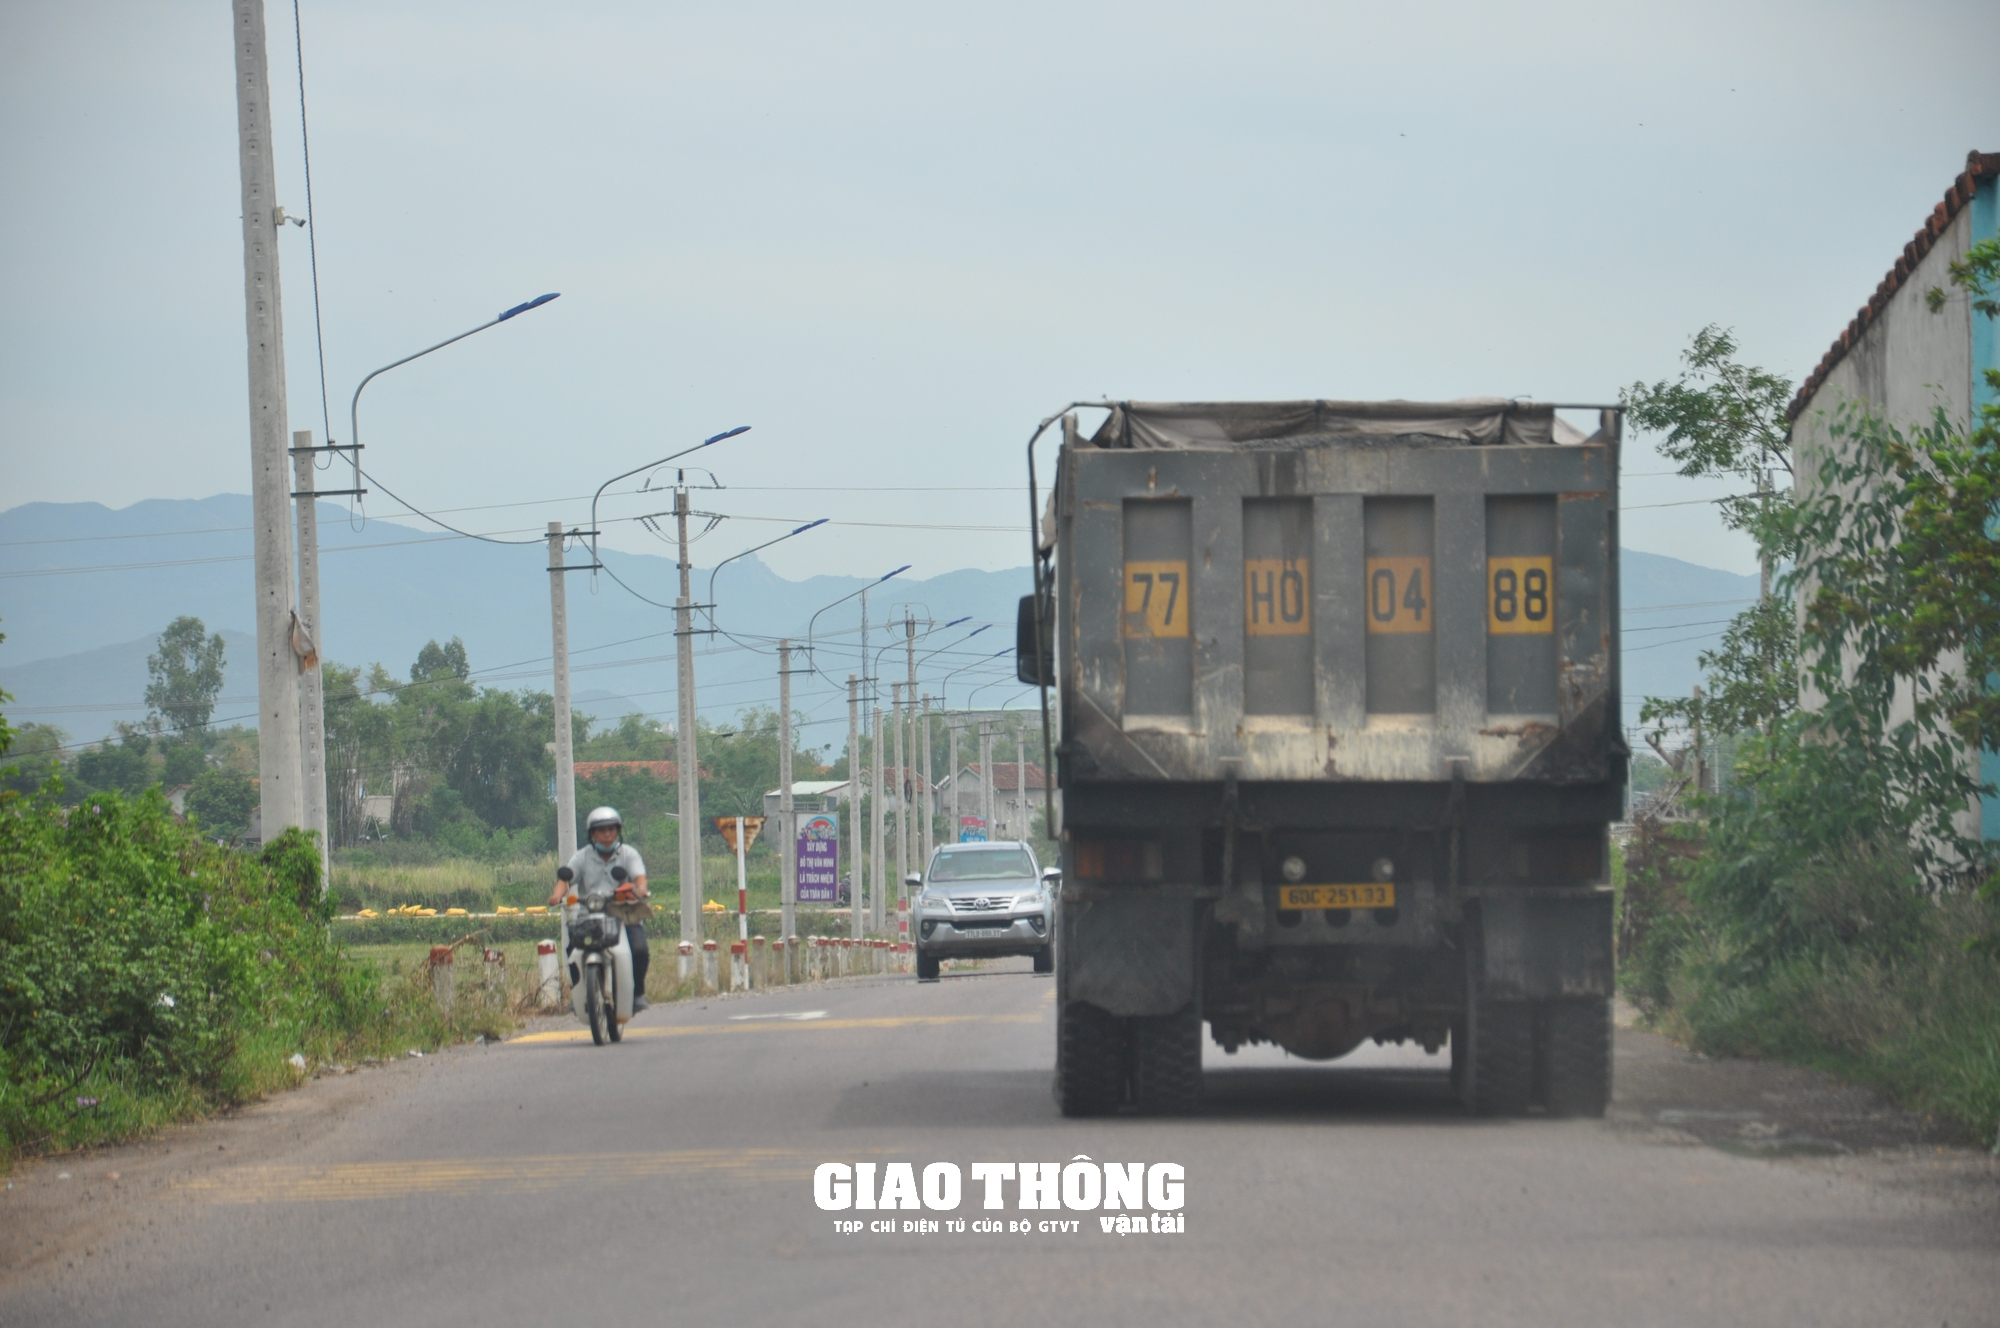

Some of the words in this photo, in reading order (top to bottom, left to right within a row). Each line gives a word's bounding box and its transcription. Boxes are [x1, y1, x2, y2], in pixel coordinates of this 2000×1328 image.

[1132, 572, 1180, 626] 77
[1371, 568, 1427, 622] 04
[1492, 567, 1549, 622] 88
[807, 840, 815, 852] XÂY
[815, 841, 828, 854] DỰNG
[823, 857, 834, 868] MINH
[806, 871, 820, 884] TRÁCH
[820, 871, 834, 885] NHIỆM
[800, 886, 809, 899] CỦA
